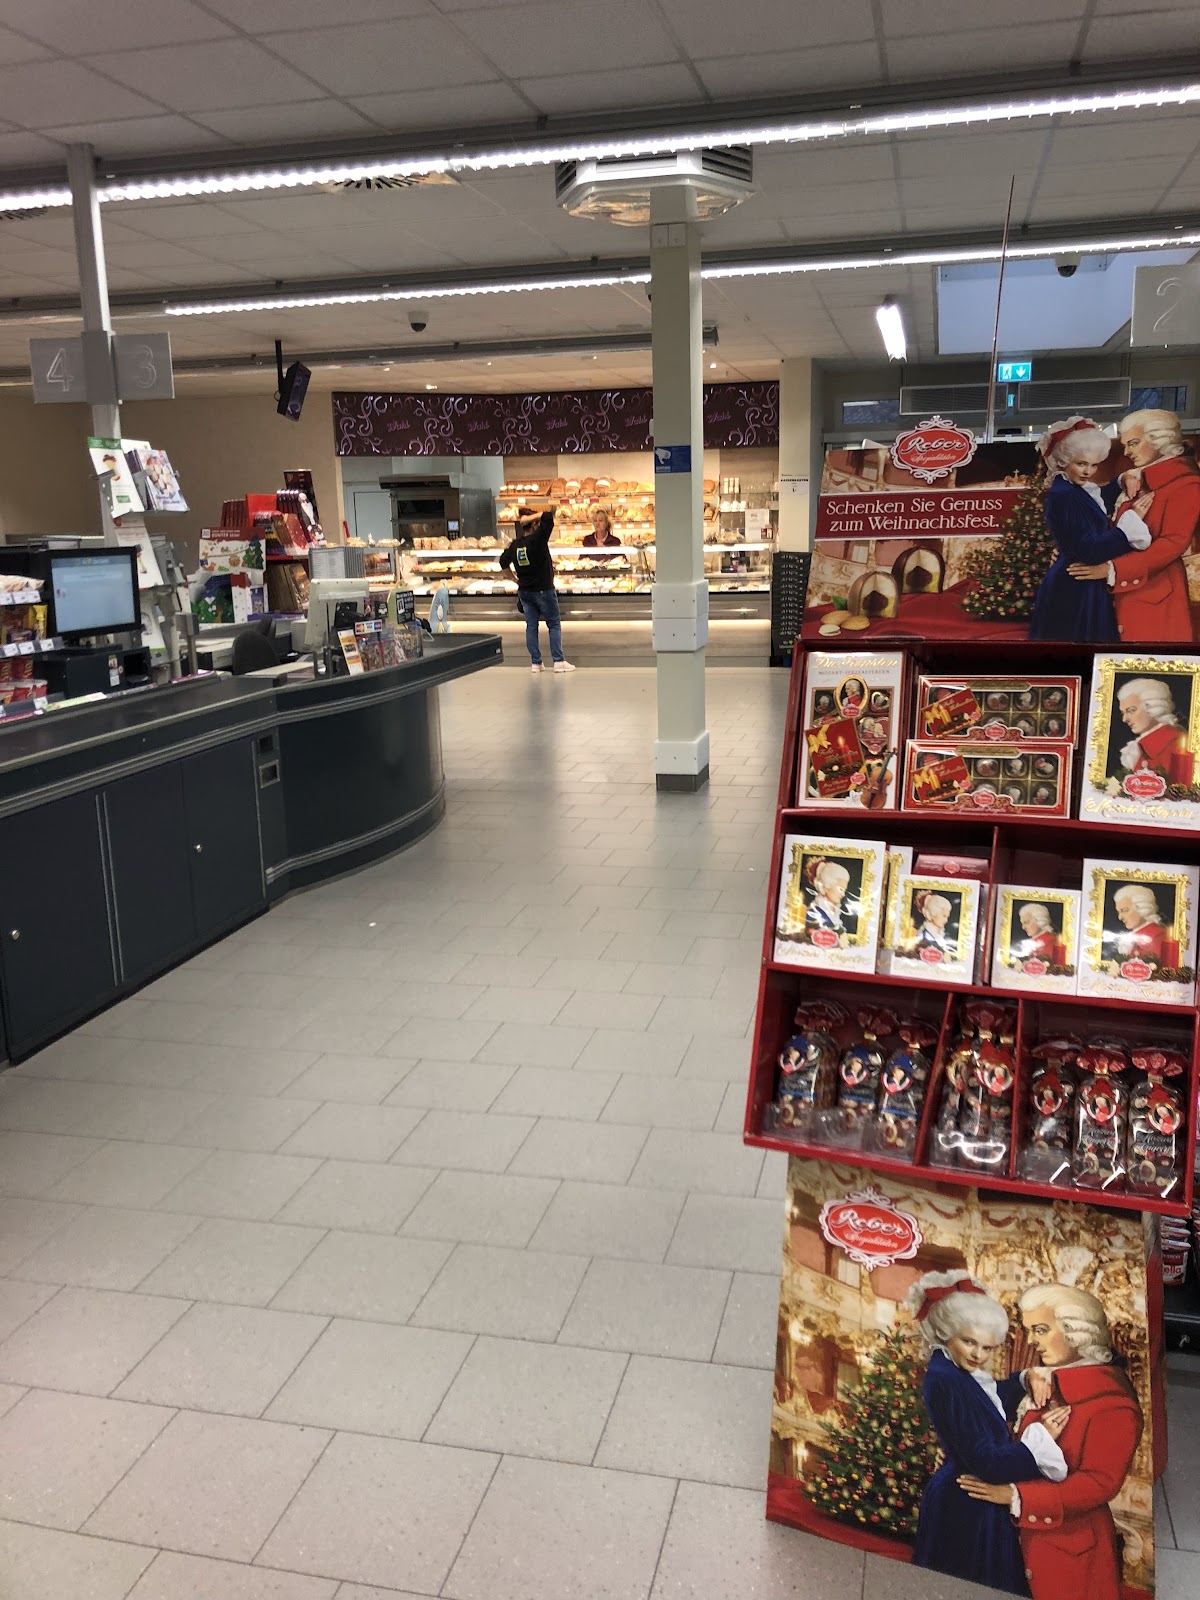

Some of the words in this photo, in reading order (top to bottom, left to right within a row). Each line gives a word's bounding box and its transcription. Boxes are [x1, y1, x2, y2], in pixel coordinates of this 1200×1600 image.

[1153, 277, 1186, 334] 2
[46, 347, 74, 392] 4
[134, 345, 157, 389] 3
[901, 436, 966, 454] Reber
[826, 500, 905, 516] Schenken
[910, 498, 936, 513] Sie
[940, 497, 1003, 512] Genuss
[829, 520, 863, 532] zum
[868, 514, 1000, 531] Weihnachtsfest.
[831, 1209, 909, 1238] Reber
[1163, 1265, 1182, 1274] ella
